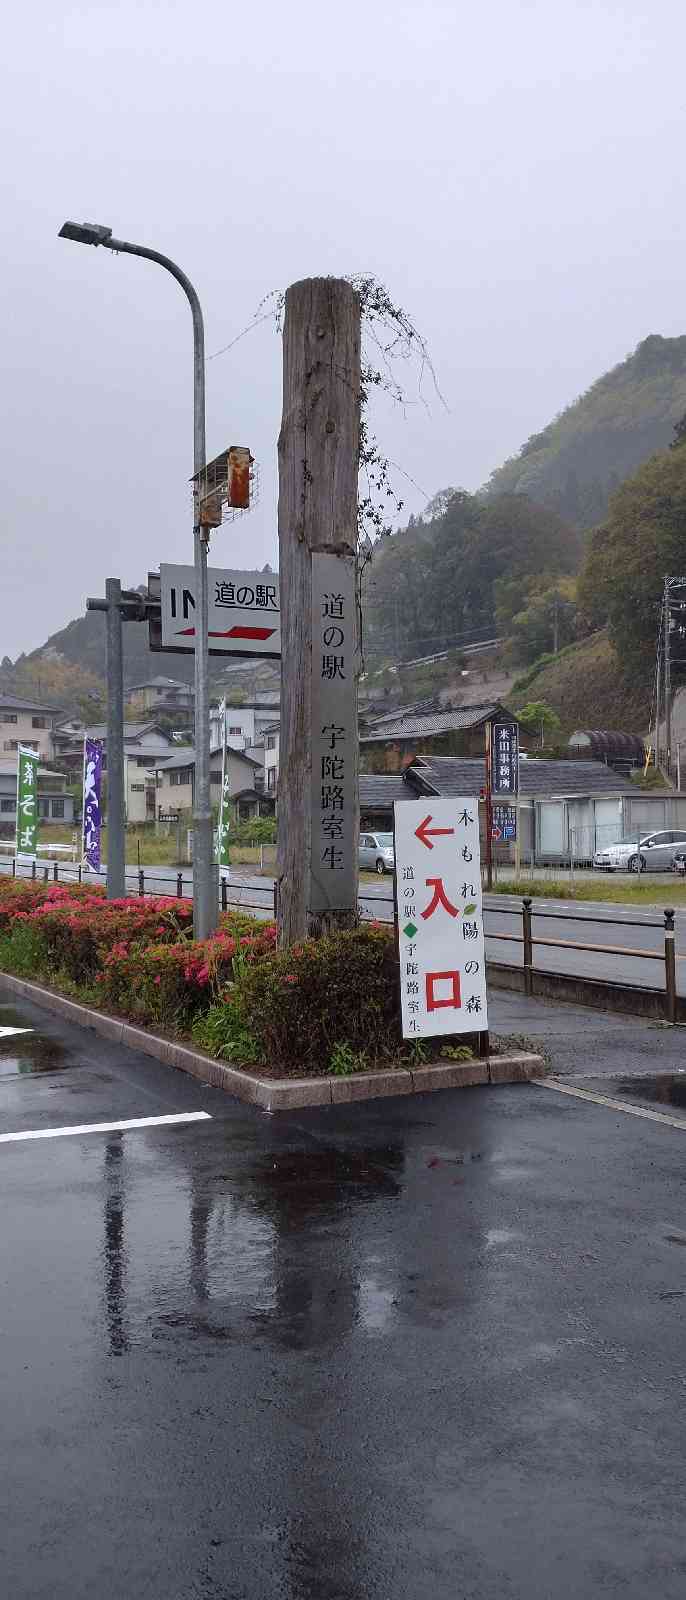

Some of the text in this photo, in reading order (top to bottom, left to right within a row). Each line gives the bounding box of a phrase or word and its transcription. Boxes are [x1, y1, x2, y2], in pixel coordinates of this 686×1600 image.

[215, 581, 277, 607] 道の駅
[321, 593, 346, 870] 道の駅 宇陀路室生
[20, 761, 35, 846] 茶そば
[420, 878, 461, 1012] 入口
